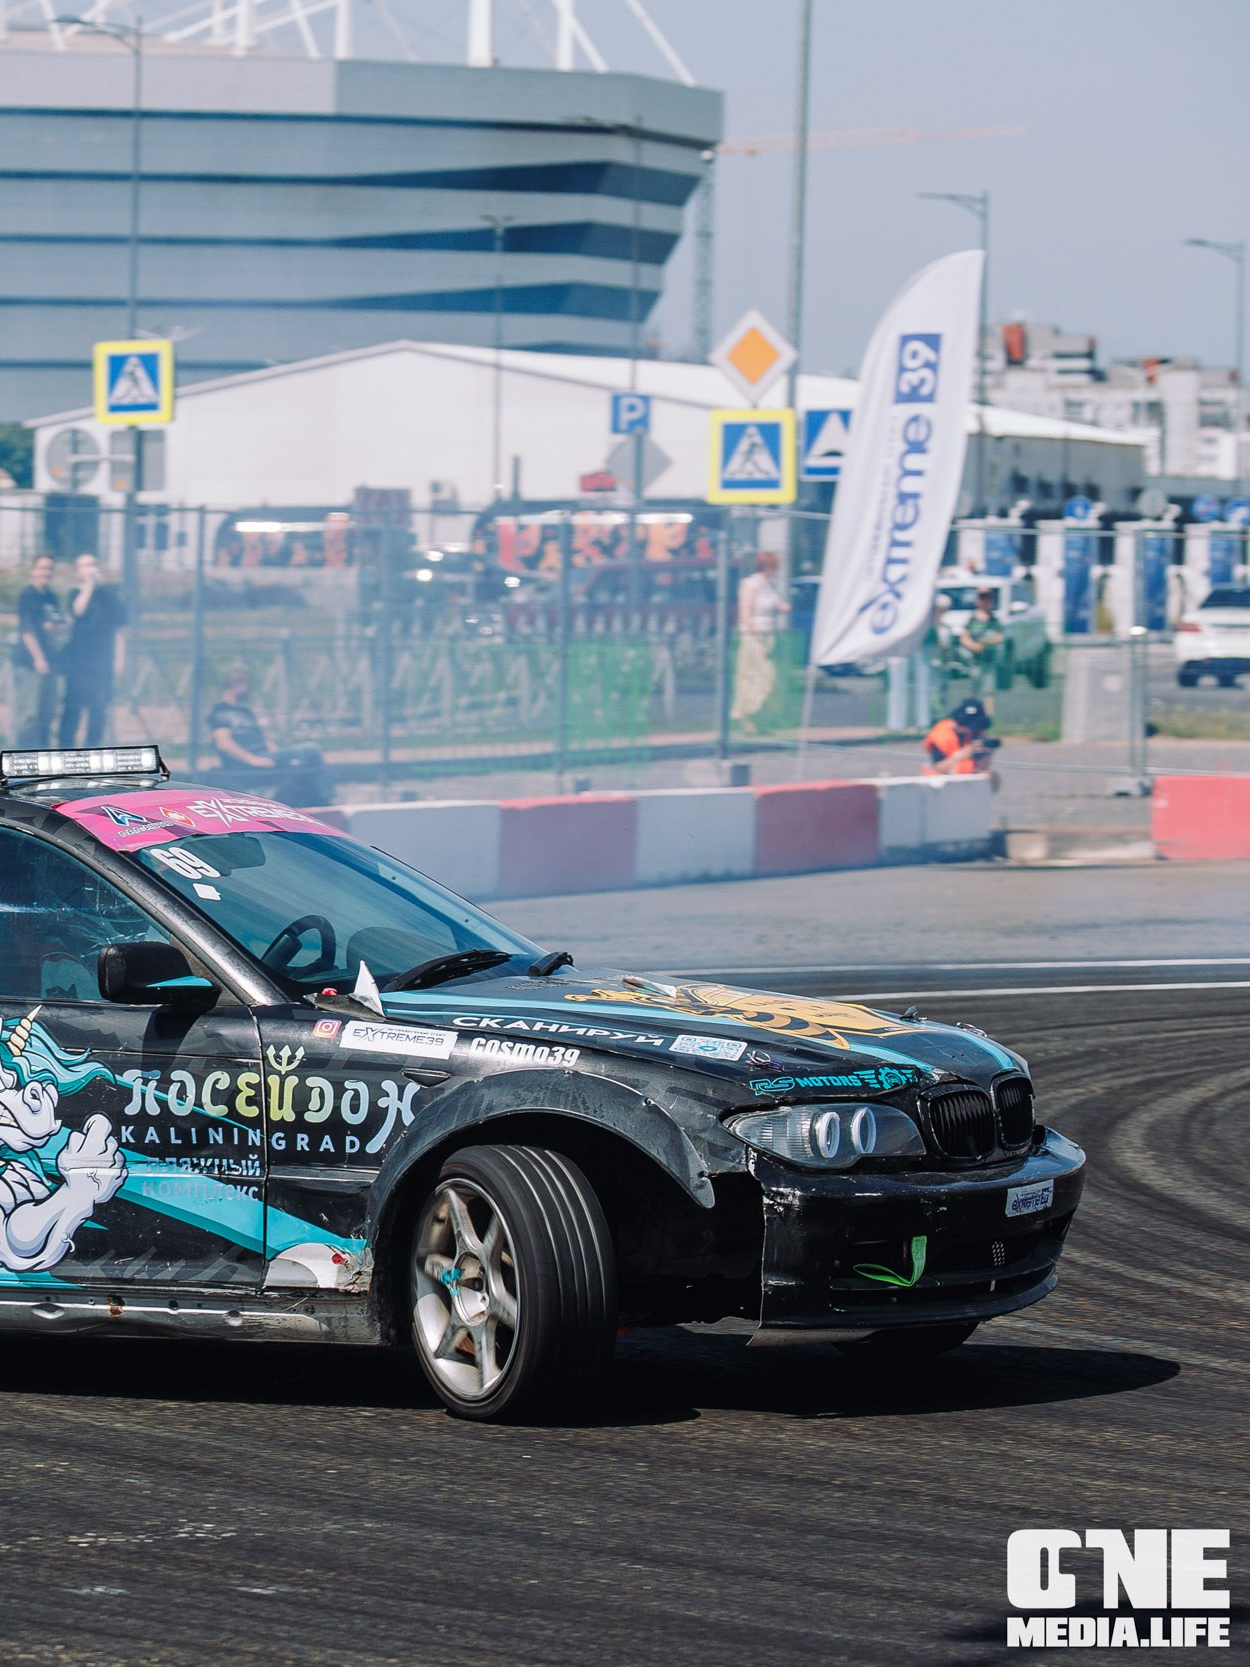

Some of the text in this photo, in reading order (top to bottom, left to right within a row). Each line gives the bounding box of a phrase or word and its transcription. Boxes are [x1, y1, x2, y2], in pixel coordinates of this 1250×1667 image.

[898, 339, 938, 396] 39
[870, 413, 932, 635] extreme
[150, 846, 221, 880] 69
[352, 1026, 445, 1046] EXTREME39
[452, 1016, 664, 1046] СКАНИРУЙ
[795, 1075, 862, 1088] MOTORS
[121, 1125, 361, 1154] KALININGRAD
